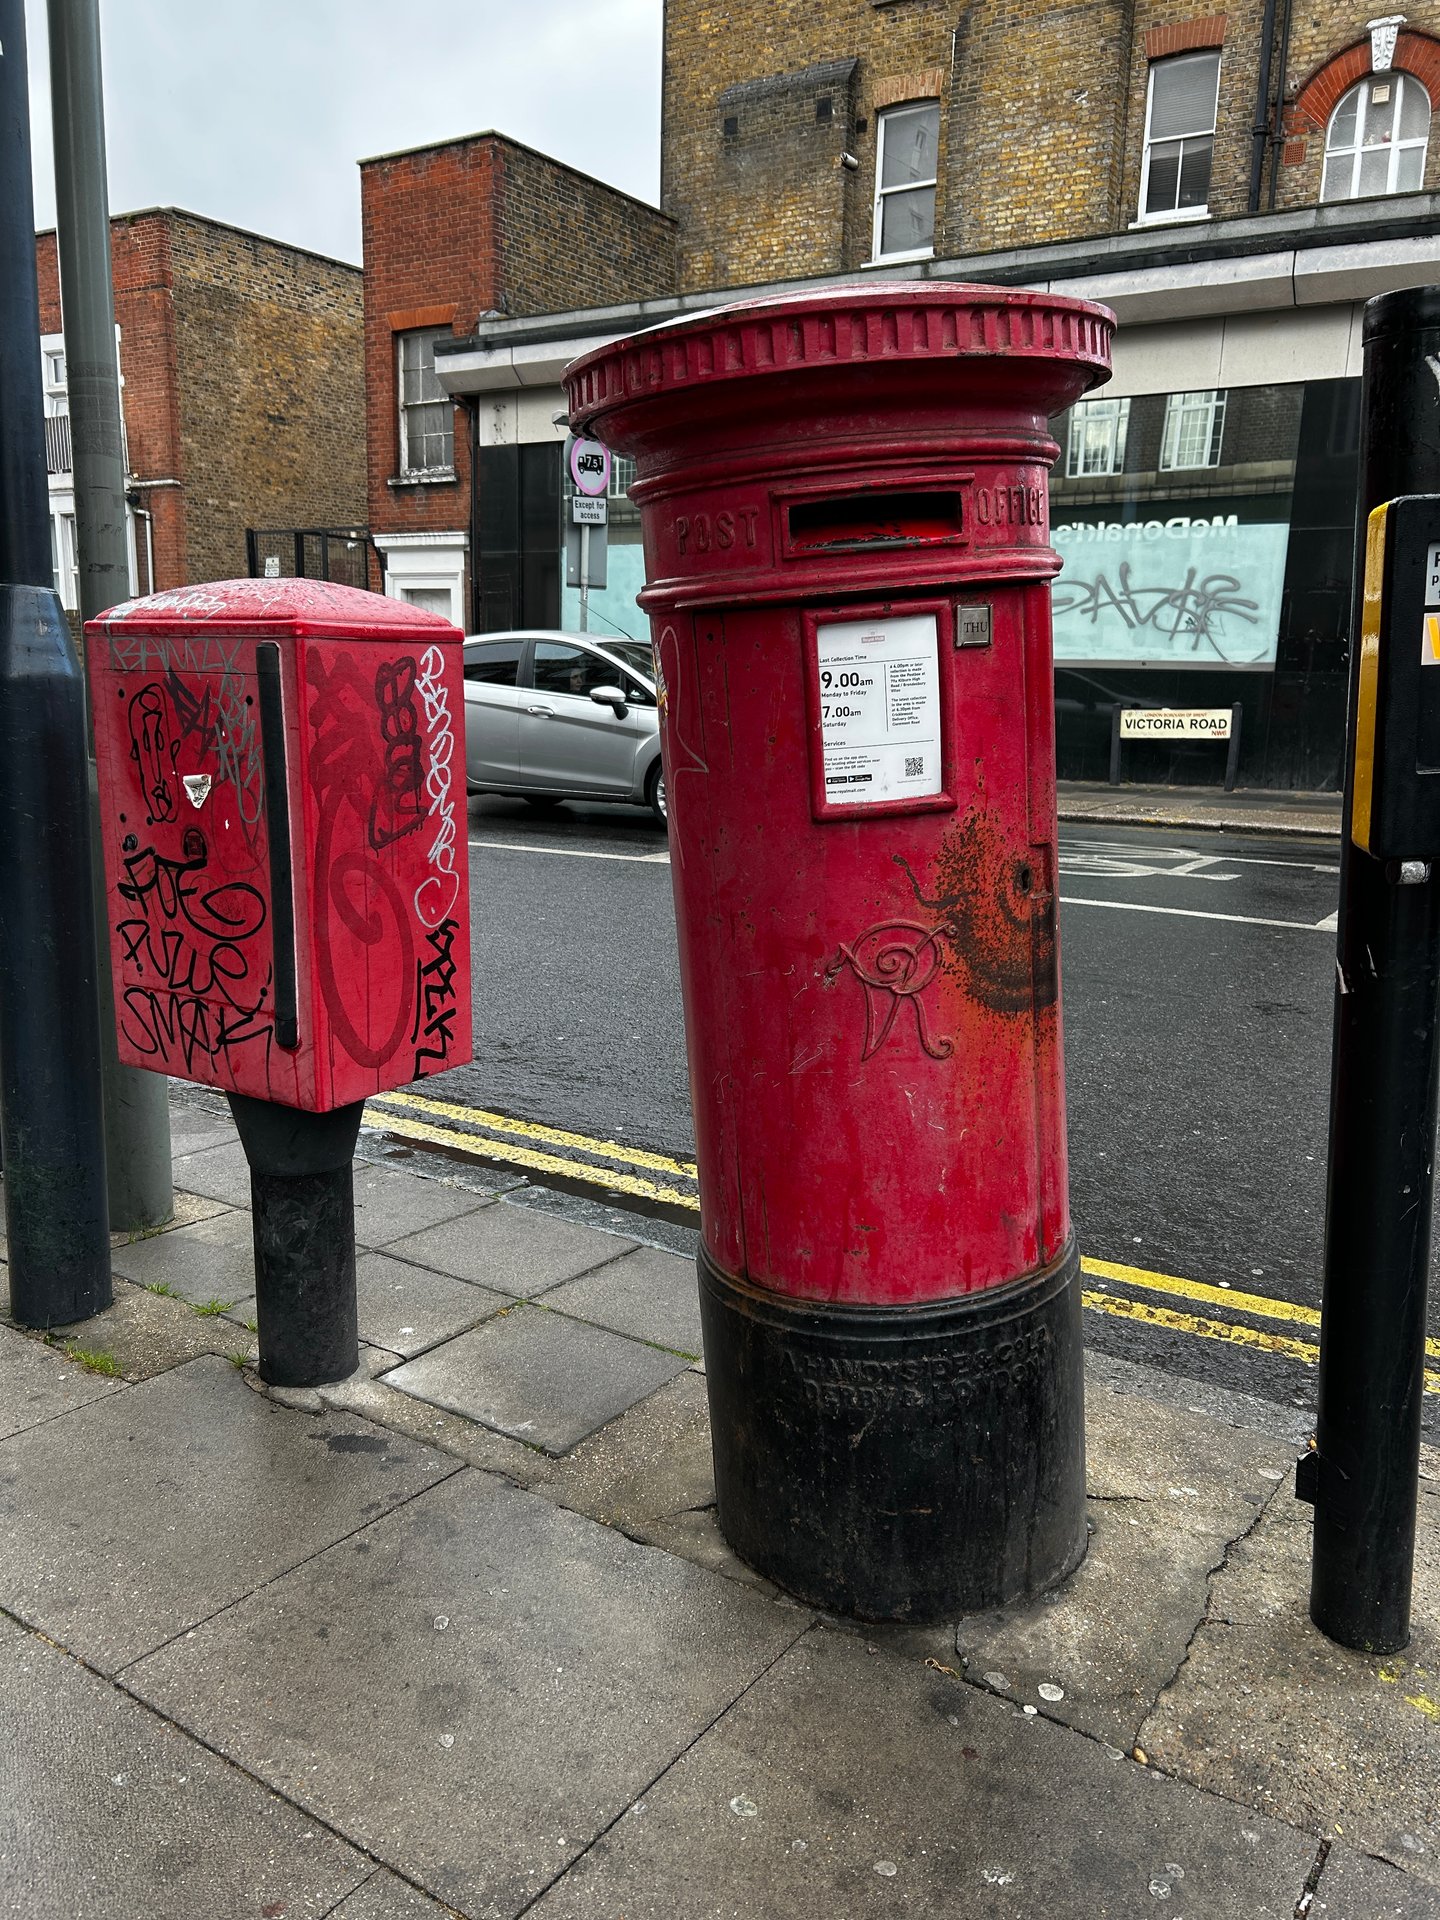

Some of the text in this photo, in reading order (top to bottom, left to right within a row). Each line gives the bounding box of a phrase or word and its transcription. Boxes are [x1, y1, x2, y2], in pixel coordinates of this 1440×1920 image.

[575, 500, 605, 510] Except for
[580, 511, 600, 520] access
[675, 486, 1045, 556] POST OFFICE
[964, 621, 988, 633] THU
[821, 671, 874, 689] 9.00am
[822, 706, 861, 718] 7.00am
[1125, 719, 1227, 729] VICTORIA ROAD
